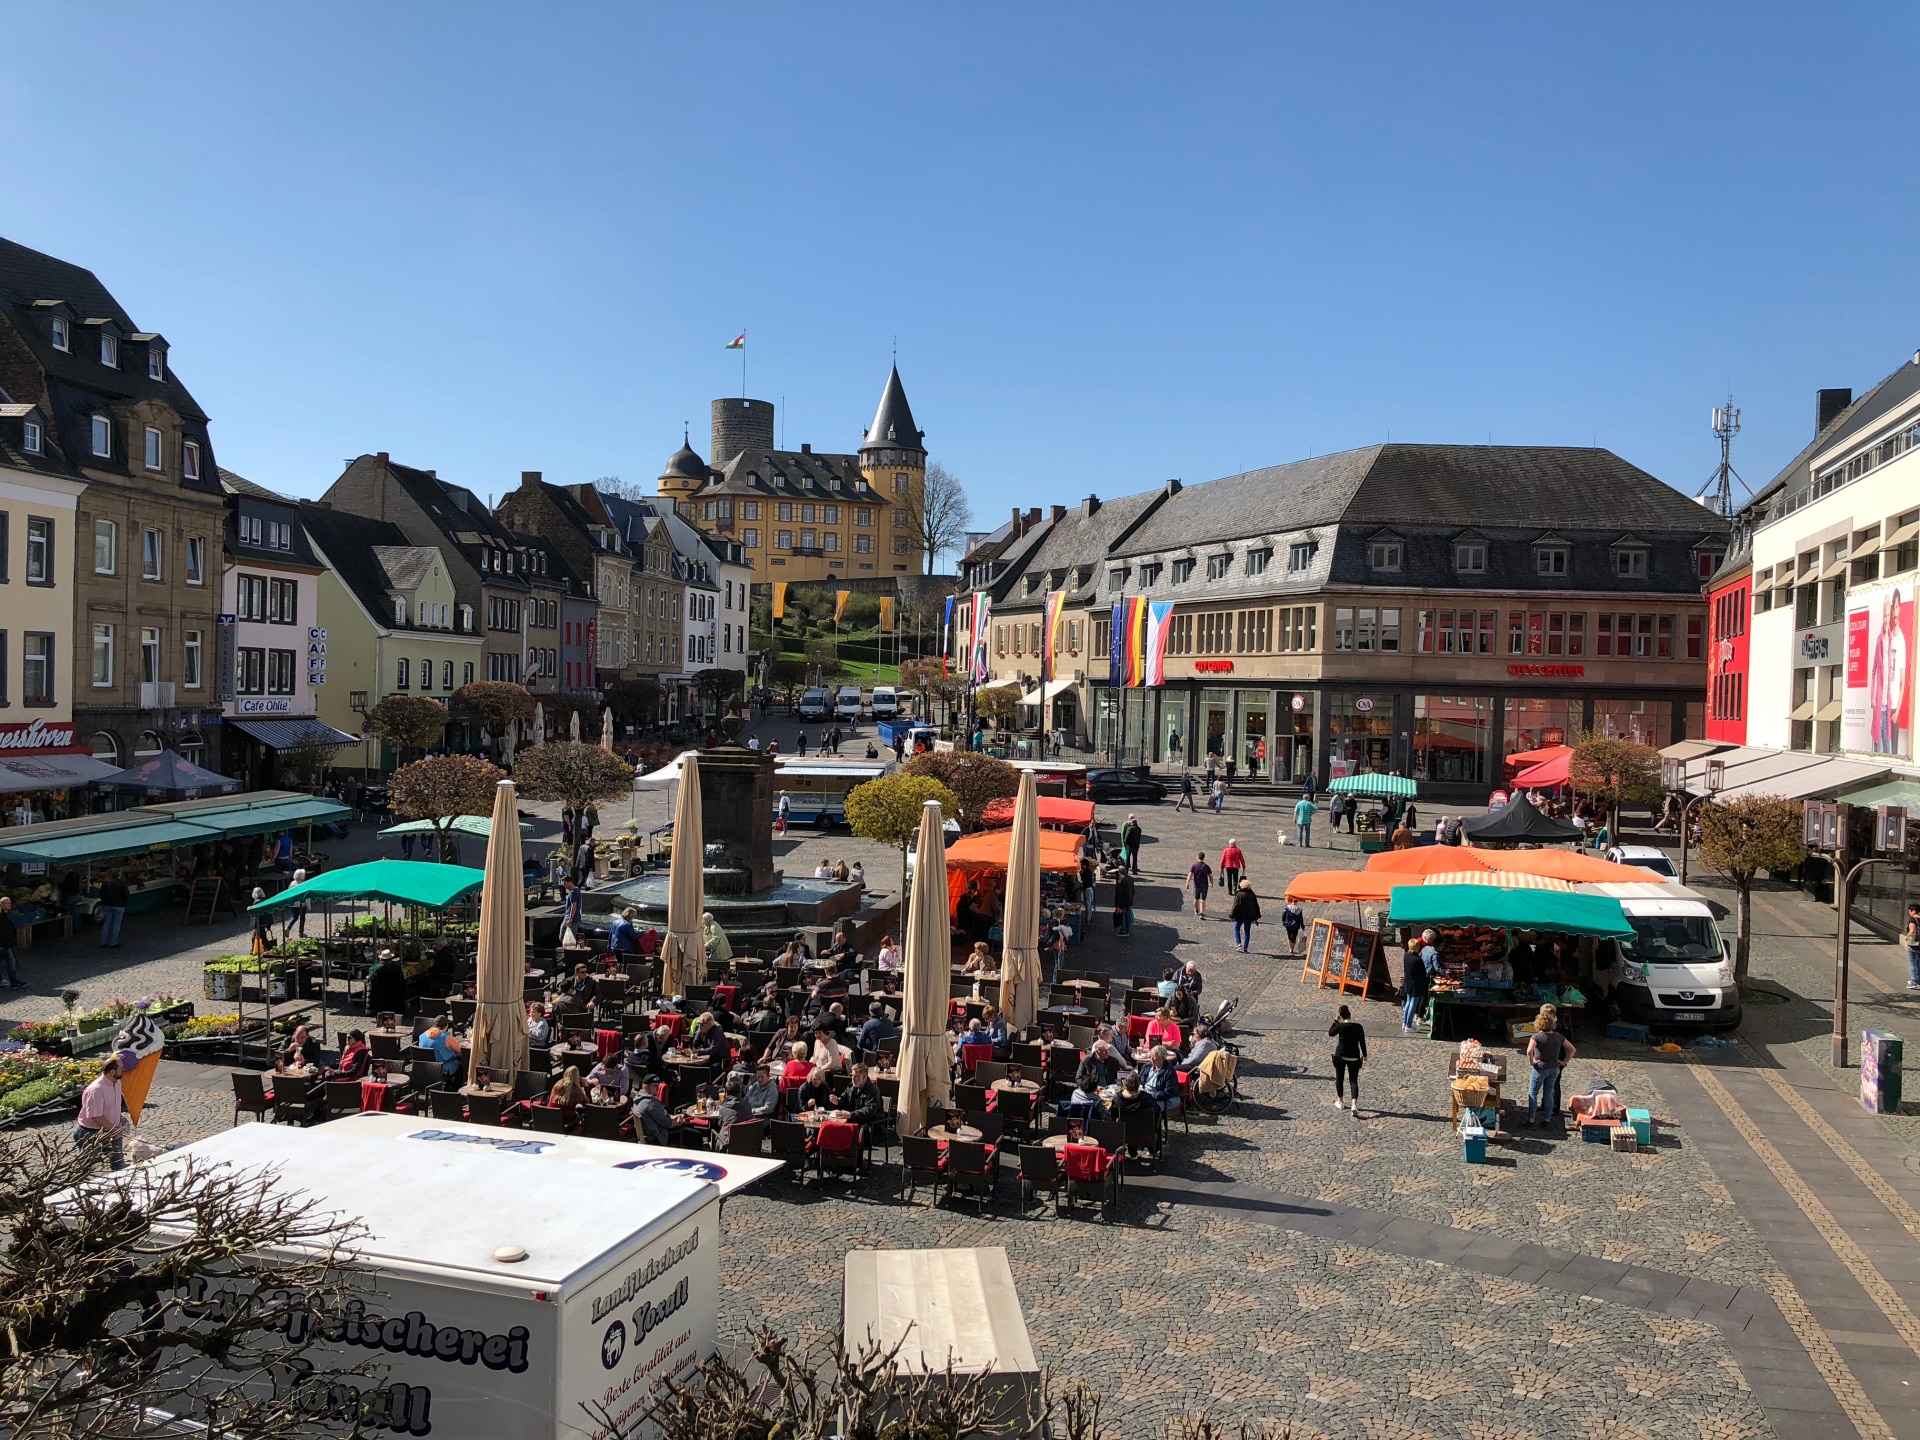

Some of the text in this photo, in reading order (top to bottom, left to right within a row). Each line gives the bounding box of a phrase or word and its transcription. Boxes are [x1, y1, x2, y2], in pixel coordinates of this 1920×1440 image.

[309, 628, 319, 684] CAFE
[1195, 661, 1233, 671] CITY CENTER
[1507, 664, 1584, 677] CITY CENTER
[244, 701, 264, 711] Cafe
[1358, 700, 1371, 709] C&A
[591, 1226, 699, 1325] Landfleischerei
[632, 1275, 689, 1347] Yoxall
[603, 1327, 692, 1410] Beste Qualität aus
